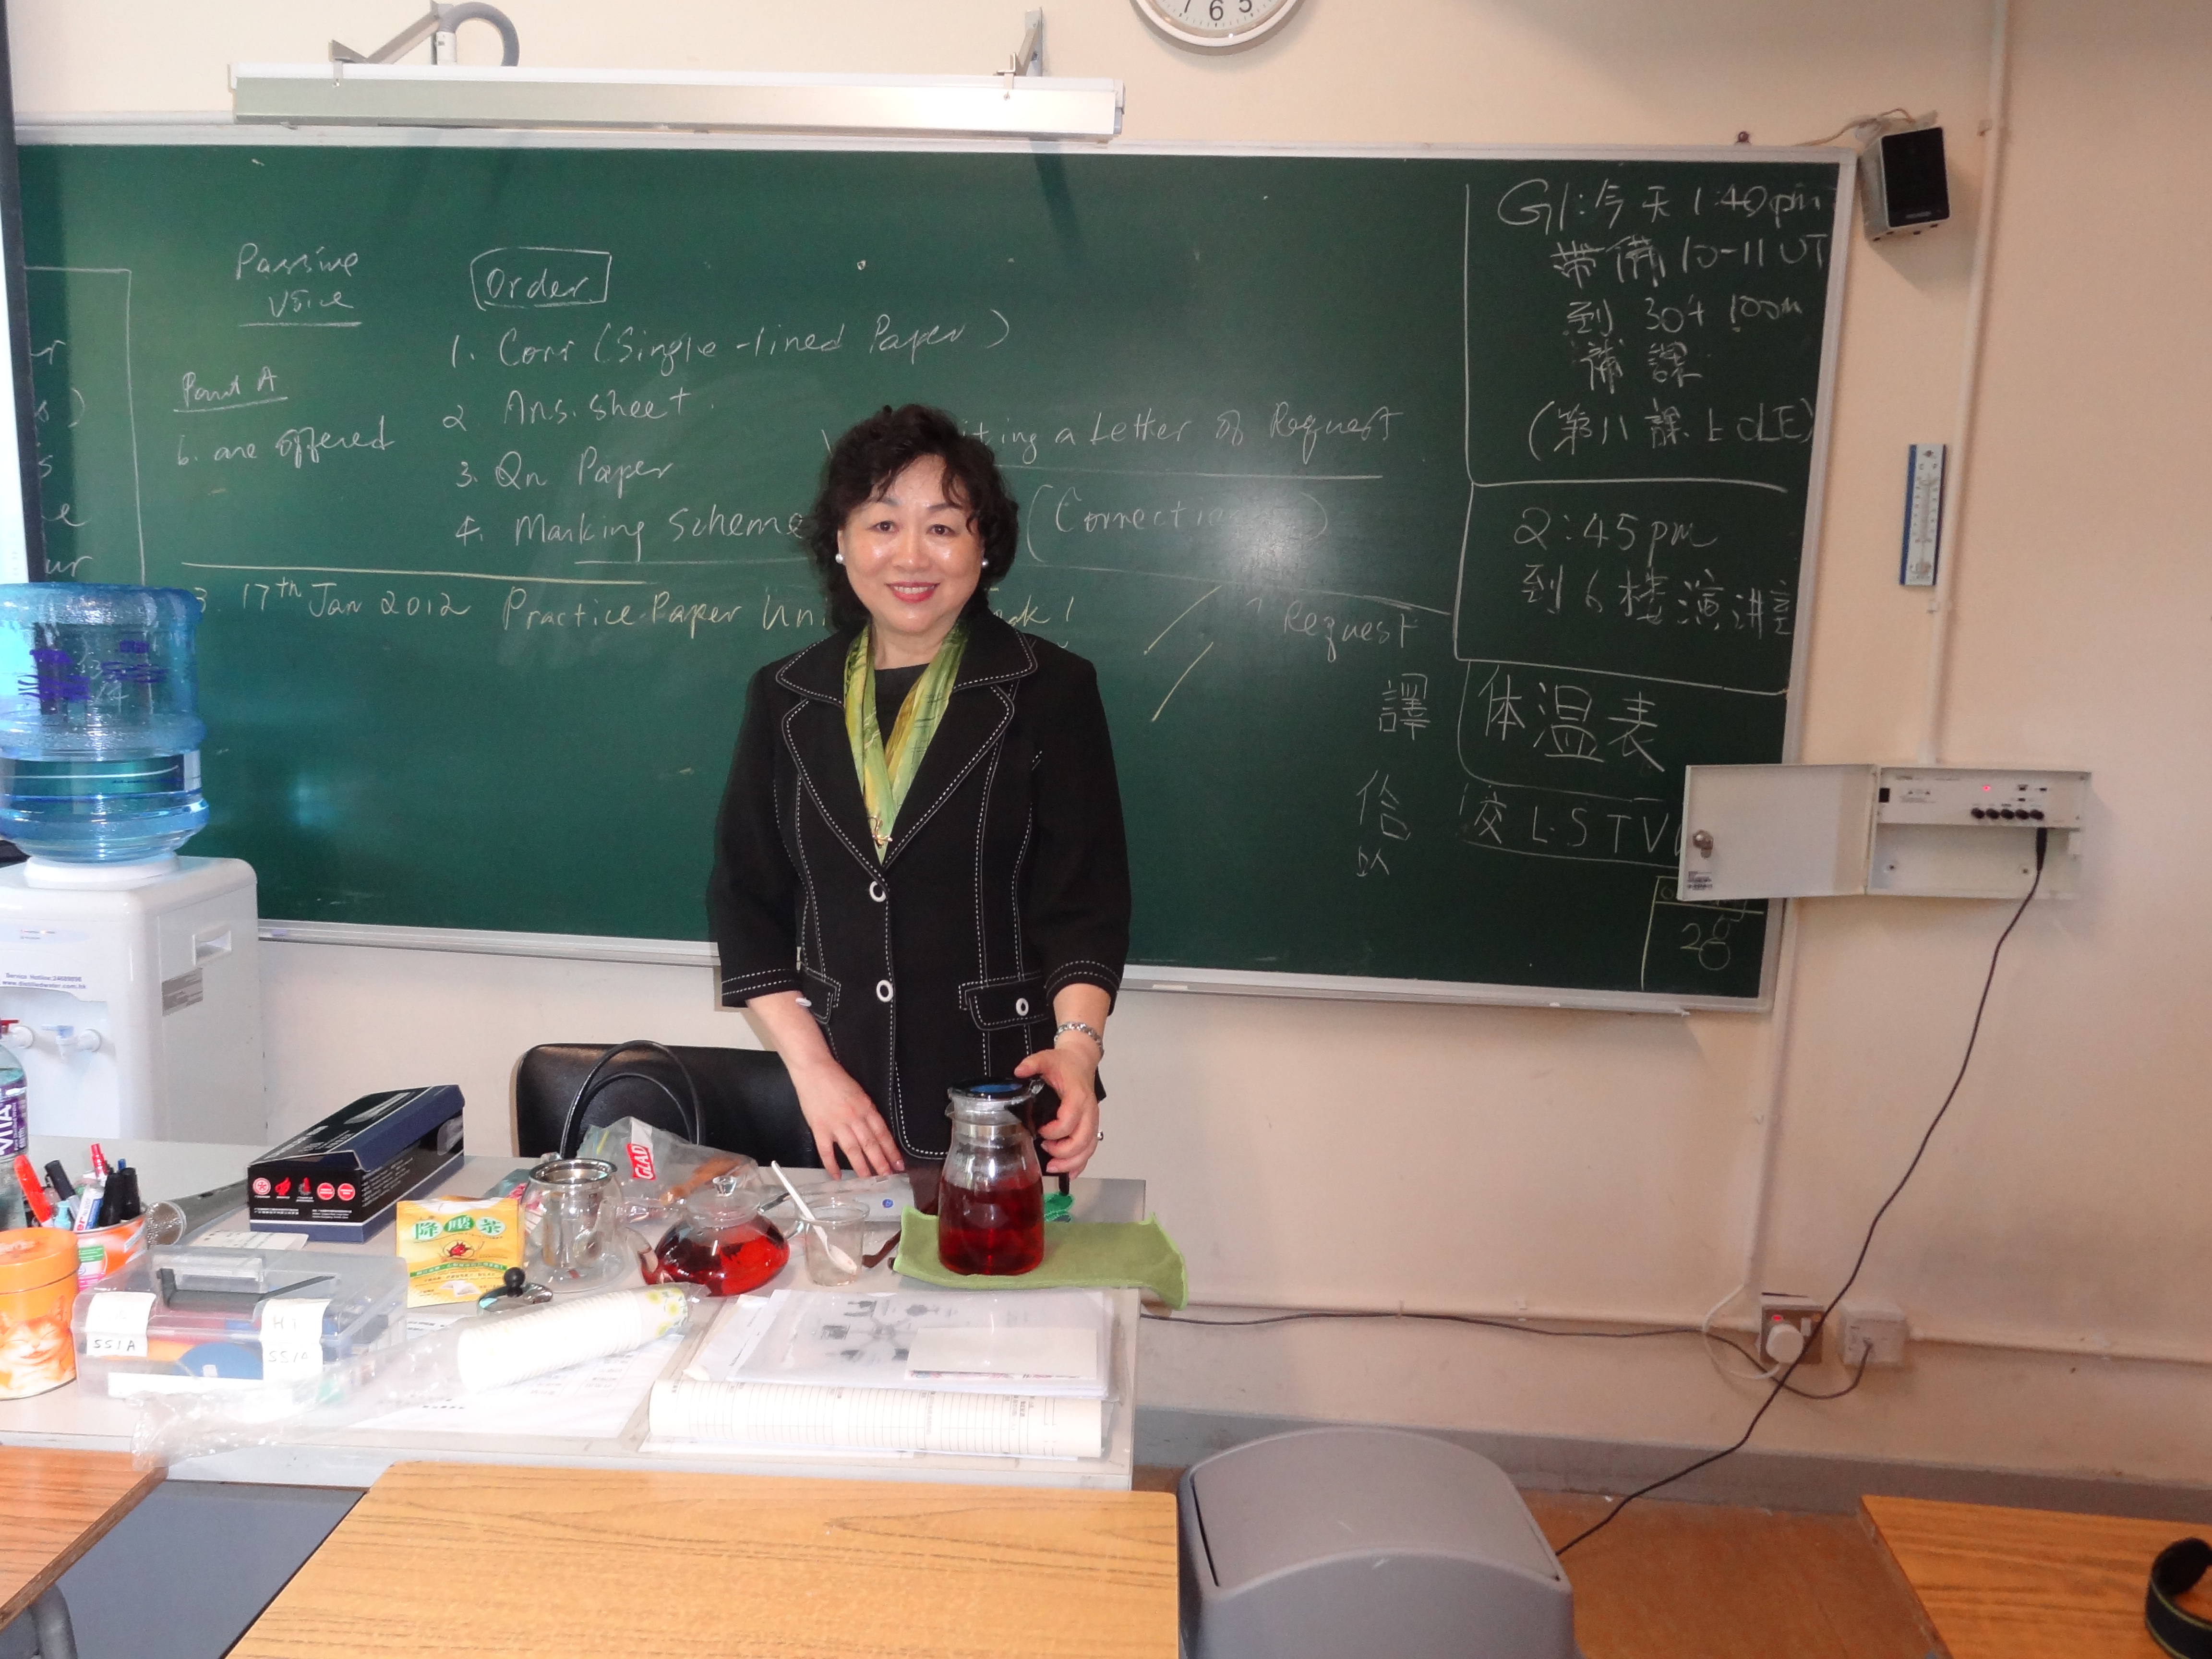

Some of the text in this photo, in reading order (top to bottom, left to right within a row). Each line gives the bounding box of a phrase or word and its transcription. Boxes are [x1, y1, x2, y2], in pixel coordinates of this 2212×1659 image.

[1209, 0, 1224, 21] 6
[486, 267, 589, 299] Order
[1056, 428, 1076, 445] a
[1270, 401, 1404, 465] Request
[578, 446, 673, 499] Paper
[515, 512, 645, 562] Marking
[309, 582, 361, 617] Jan
[381, 590, 471, 616] 2012
[763, 594, 830, 630] Uni
[631, 1145, 654, 1179] GLAD
